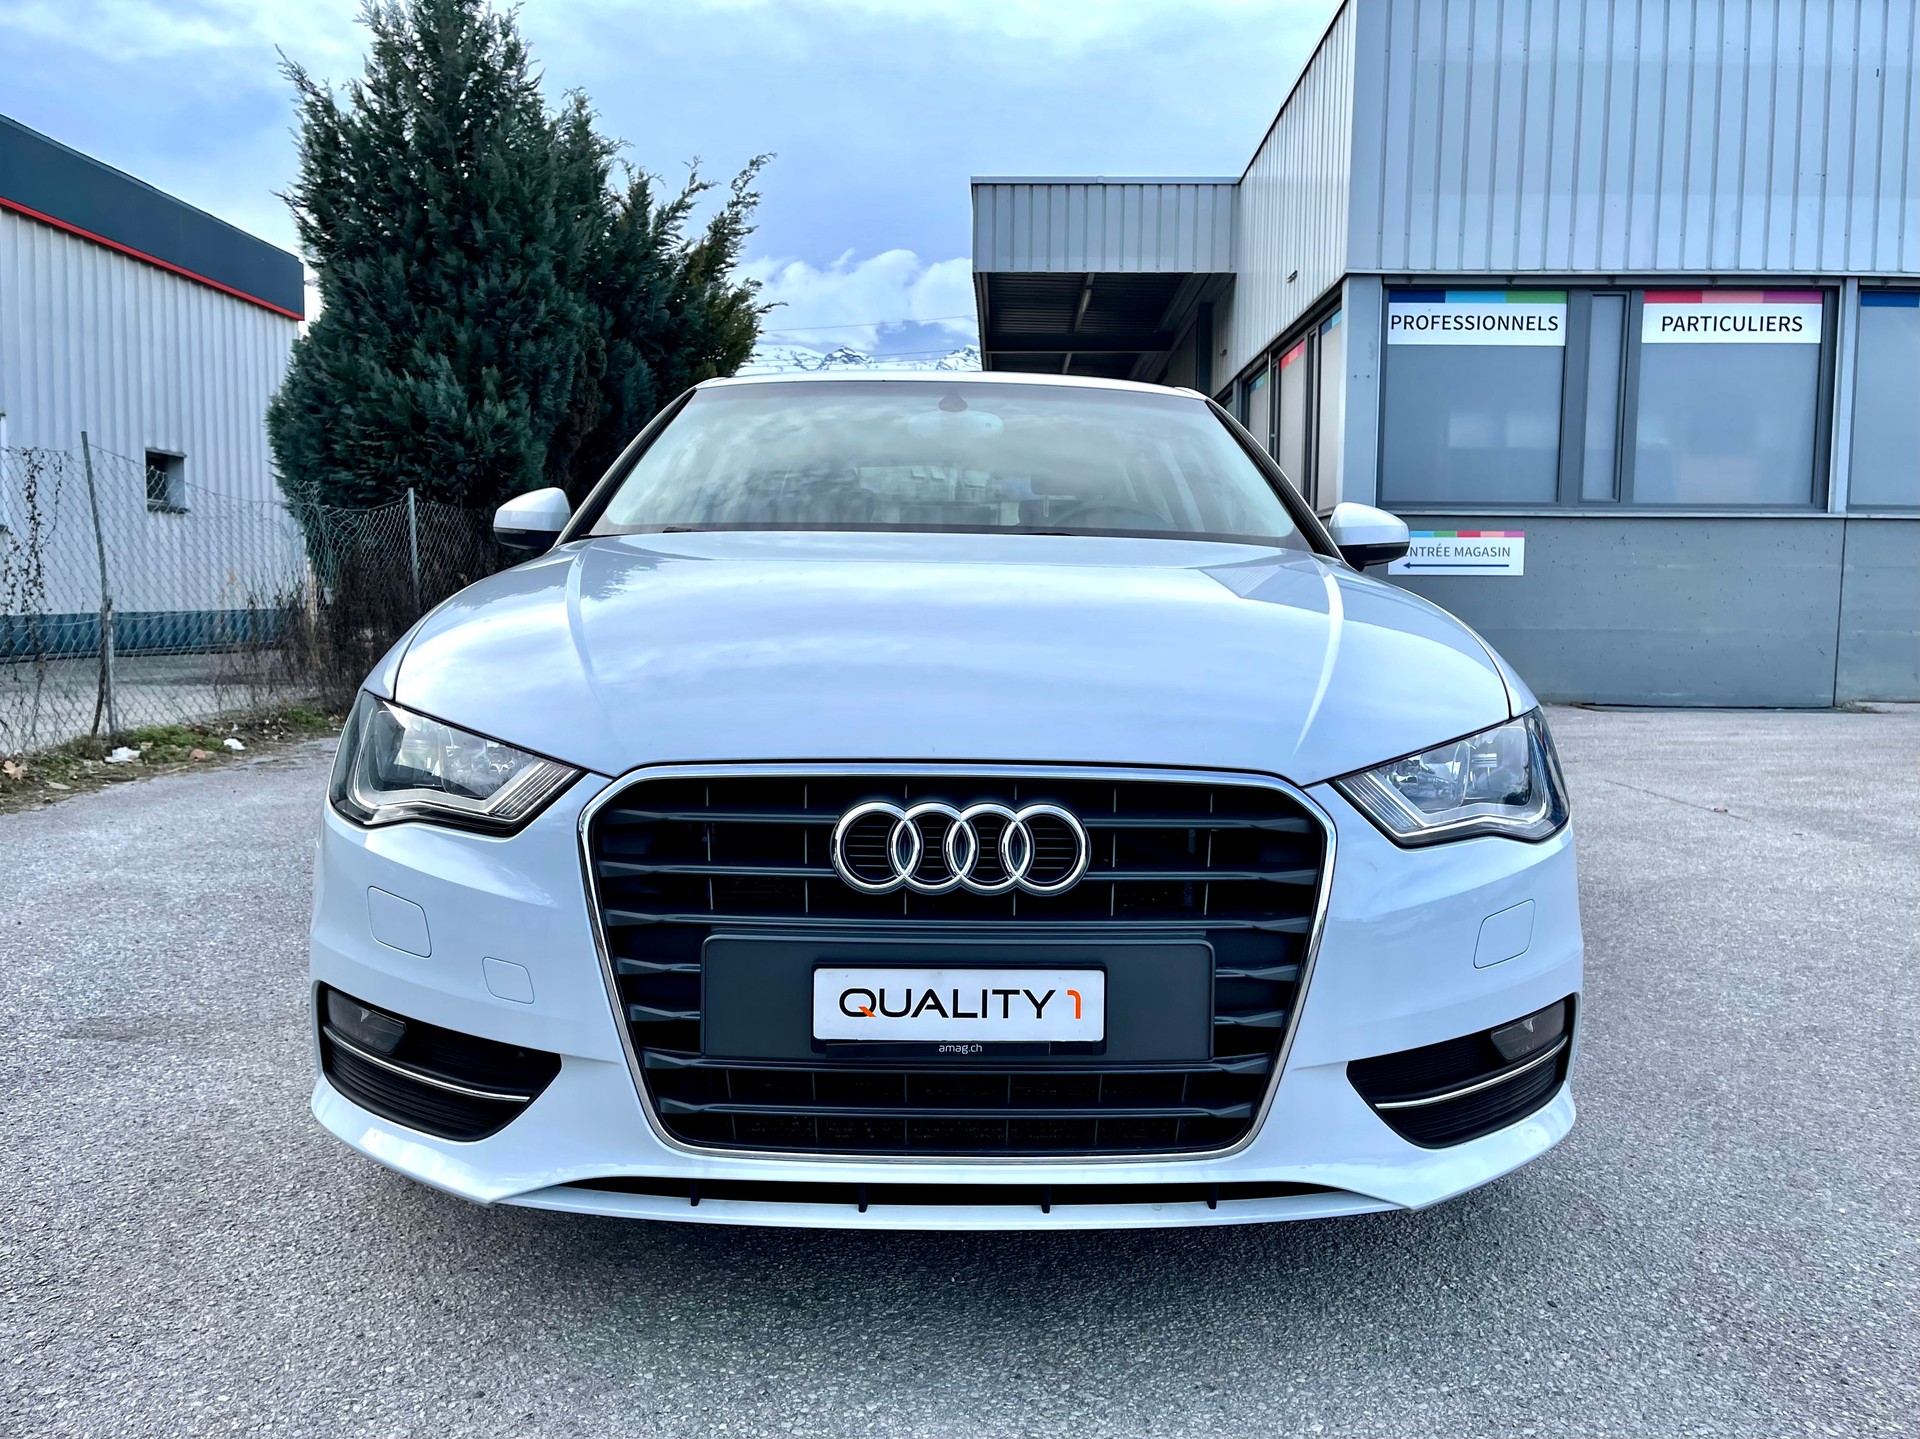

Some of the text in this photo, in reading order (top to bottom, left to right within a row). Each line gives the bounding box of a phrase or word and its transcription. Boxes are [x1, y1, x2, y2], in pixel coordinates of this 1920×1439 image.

[1391, 315, 1558, 331] PROFESSIONNELS
[1662, 315, 1803, 332] PARTICULIERS
[1405, 543, 1511, 558] NTRÉE MAGASIN
[839, 988, 1056, 1019] QUALITY
[938, 1043, 983, 1054] amag.ch
